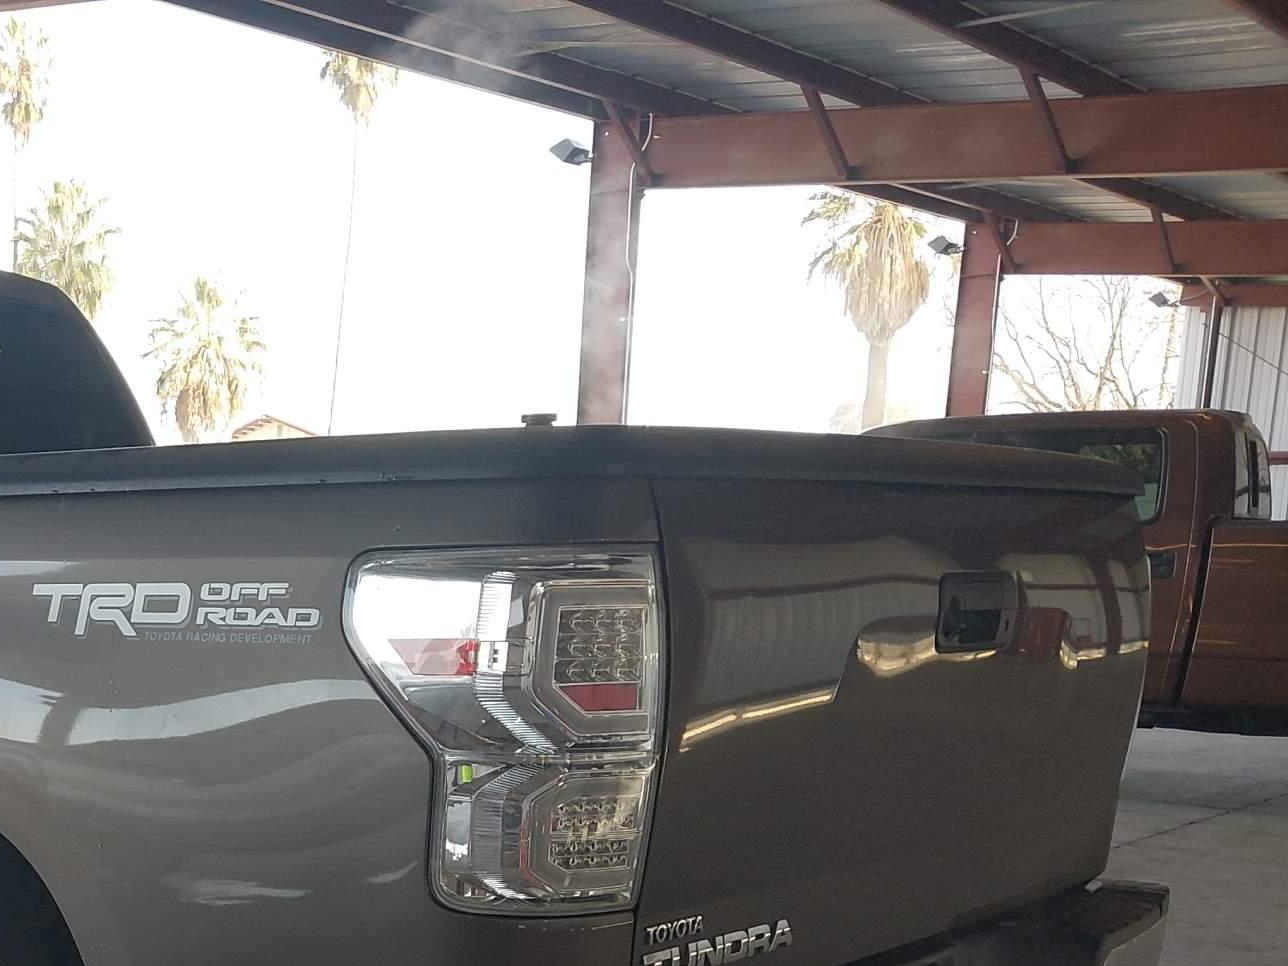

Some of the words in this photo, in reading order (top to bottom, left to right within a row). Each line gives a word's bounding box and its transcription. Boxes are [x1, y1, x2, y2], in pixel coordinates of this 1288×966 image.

[199, 582, 292, 602] OFF
[32, 582, 194, 638] TRD
[196, 607, 323, 628] ROAD
[144, 631, 183, 642] TOYOTA
[186, 632, 226, 643] RACING
[229, 632, 313, 645] DEVELOPMENT
[646, 915, 703, 946] TOYOTA
